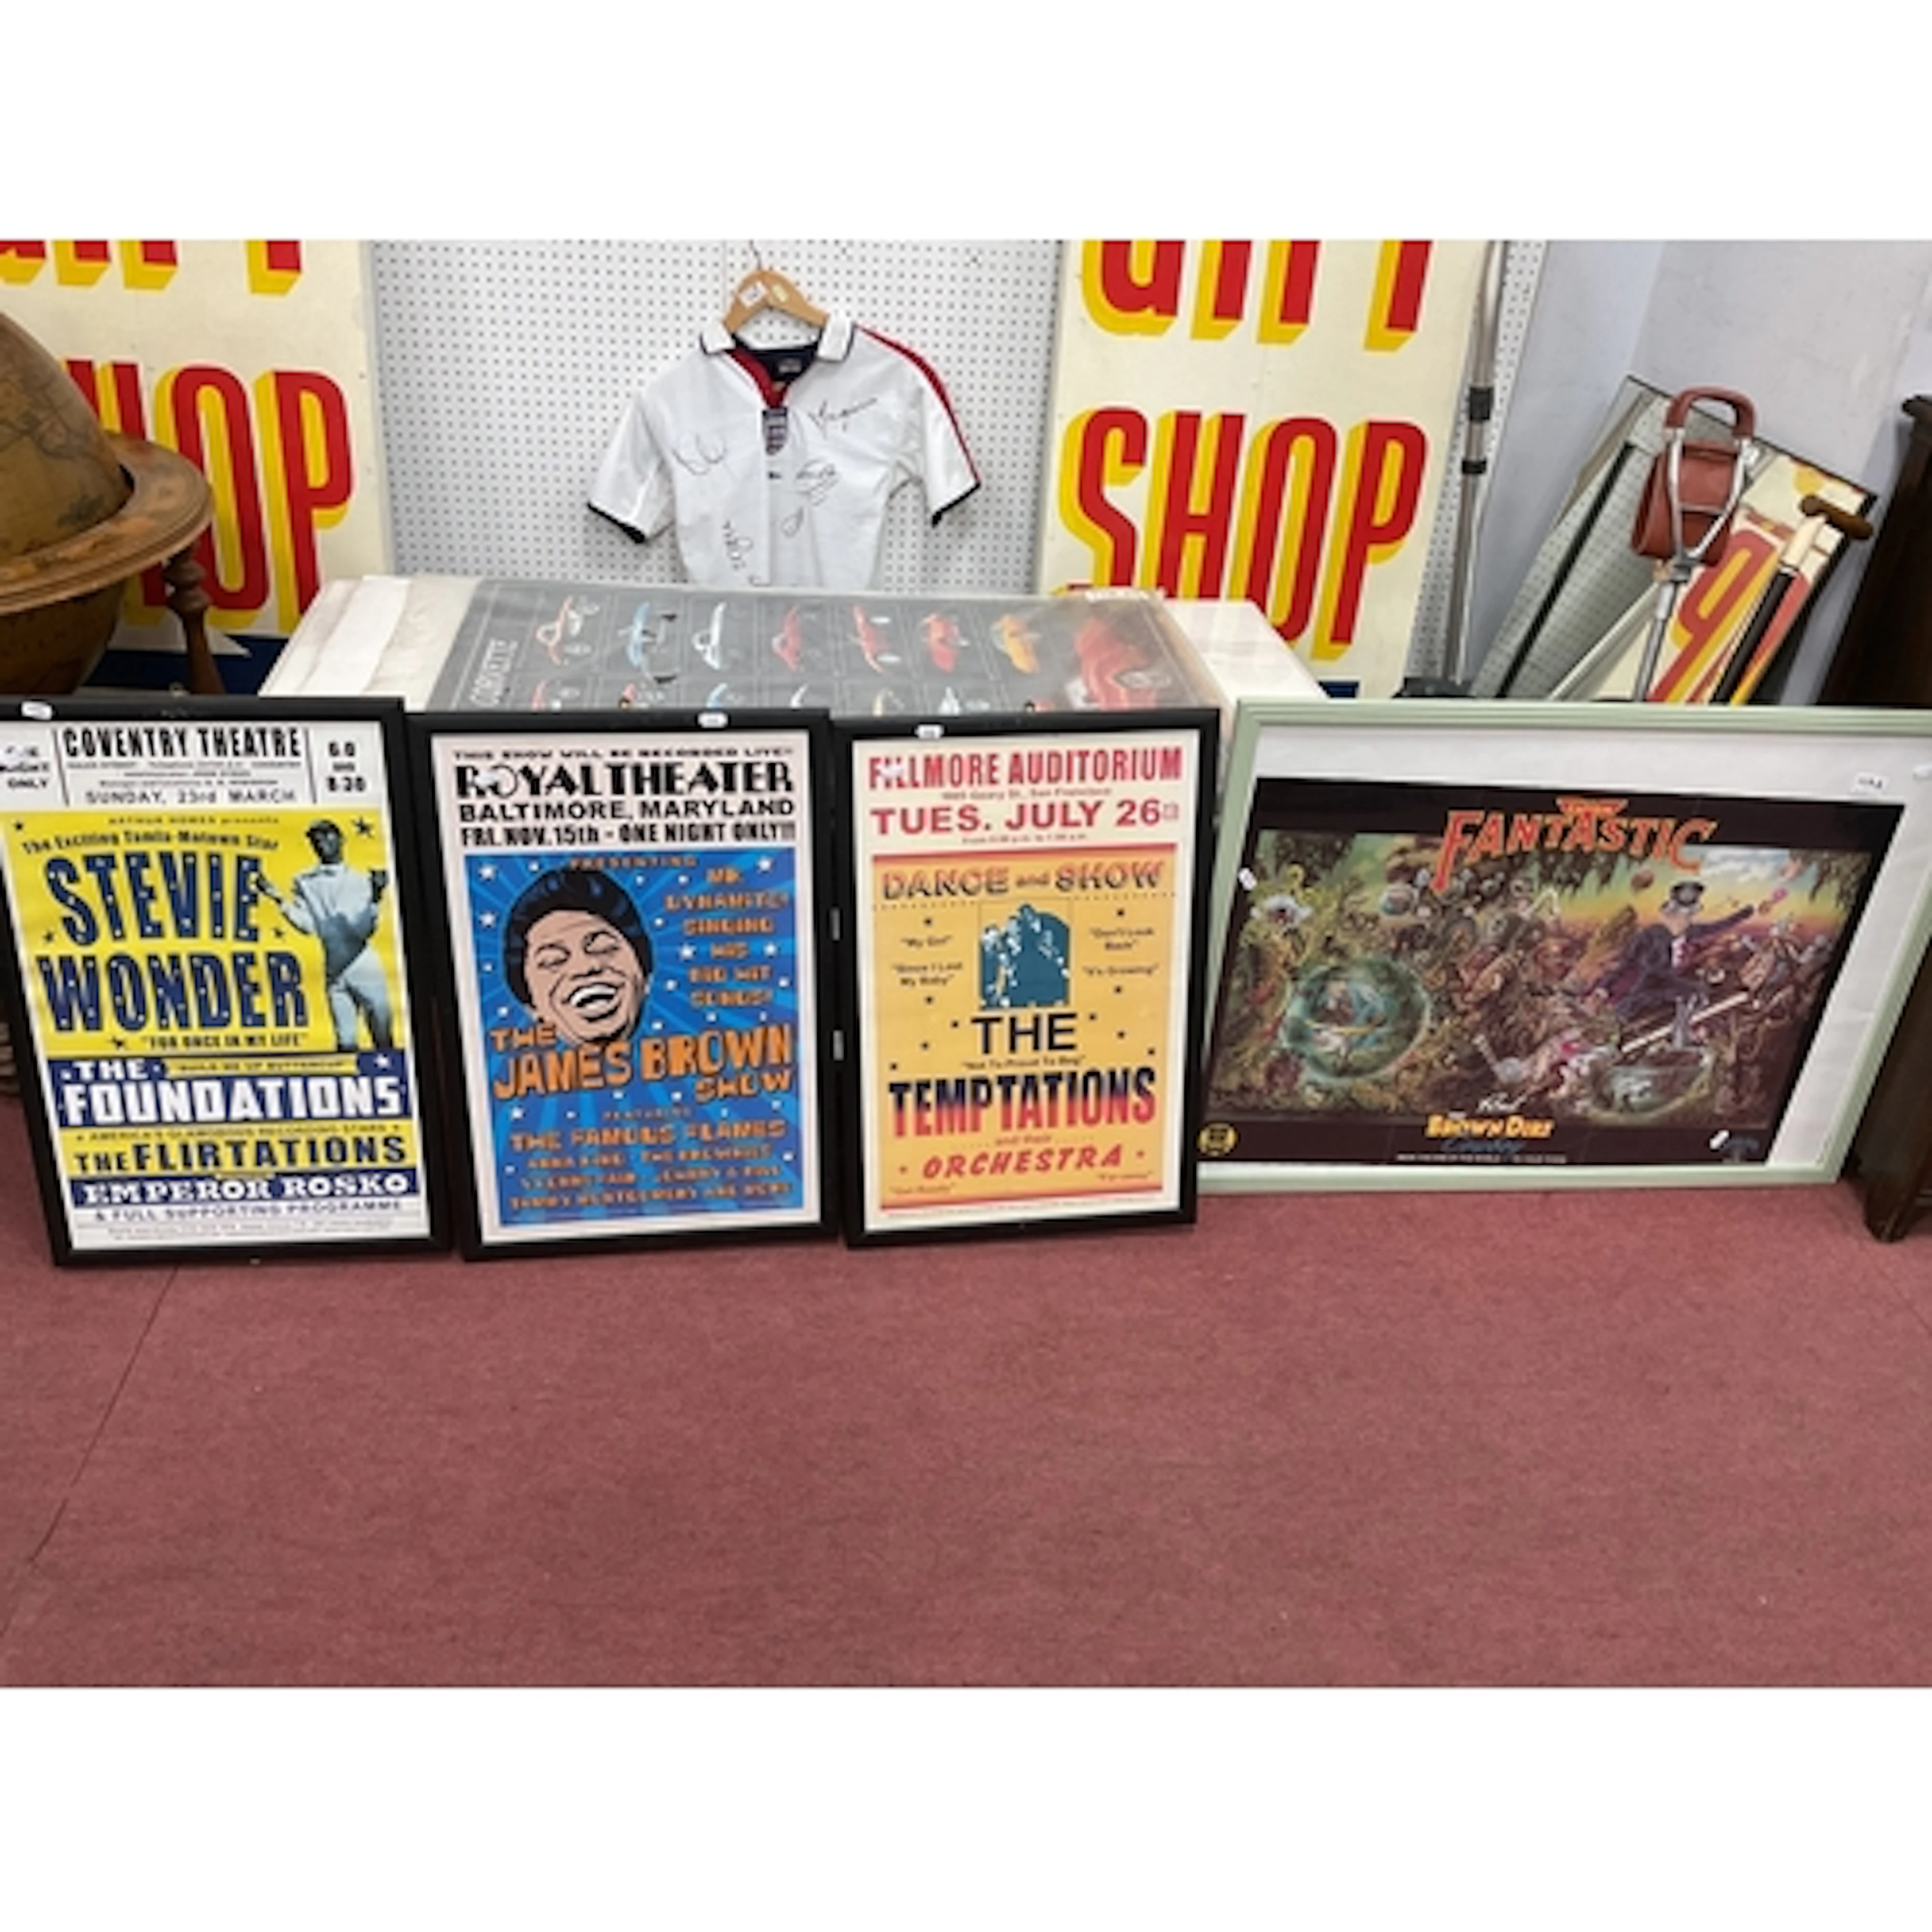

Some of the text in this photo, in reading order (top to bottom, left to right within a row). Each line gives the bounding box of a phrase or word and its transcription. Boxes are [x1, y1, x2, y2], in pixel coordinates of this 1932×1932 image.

[63, 358, 355, 631] OP
[1058, 407, 1429, 662] SHOP
[63, 727, 301, 757] COVENTRY THEATRE
[455, 761, 792, 798] ROYAL THEATER
[1009, 747, 1183, 785] AUDITORIUM
[229, 788, 296, 803] MARCH
[460, 799, 793, 822] BALTIMORE, MARYLAND
[553, 824, 600, 845] 15th
[619, 824, 659, 842] ONE
[665, 824, 726, 842] NIGHT
[870, 804, 991, 835] TUES.
[1005, 800, 1104, 830] JULY
[1115, 799, 1161, 827] 26
[1430, 809, 1717, 896] FANTASTIC
[44, 850, 263, 946] STEVIE
[882, 867, 1008, 901] DANCE
[1056, 861, 1165, 893] SHOW
[36, 950, 309, 1031] WONDER
[491, 1025, 555, 1052] THE
[971, 1012, 1077, 1054] THE
[72, 1059, 149, 1081] THE
[492, 1024, 793, 1099] JAMES BROWN
[61, 1076, 401, 1127] FOUNDATIONS
[695, 1069, 791, 1102] SHOW
[889, 1067, 1156, 1137] TEMPTATIONS
[74, 1136, 407, 1172] THE FLIRTATIONS
[510, 1119, 786, 1153] THE FAMOUS FLAMES
[922, 1144, 1122, 1179] ORCHESTRA
[83, 1173, 409, 1205] EMPEROR ROSKO
